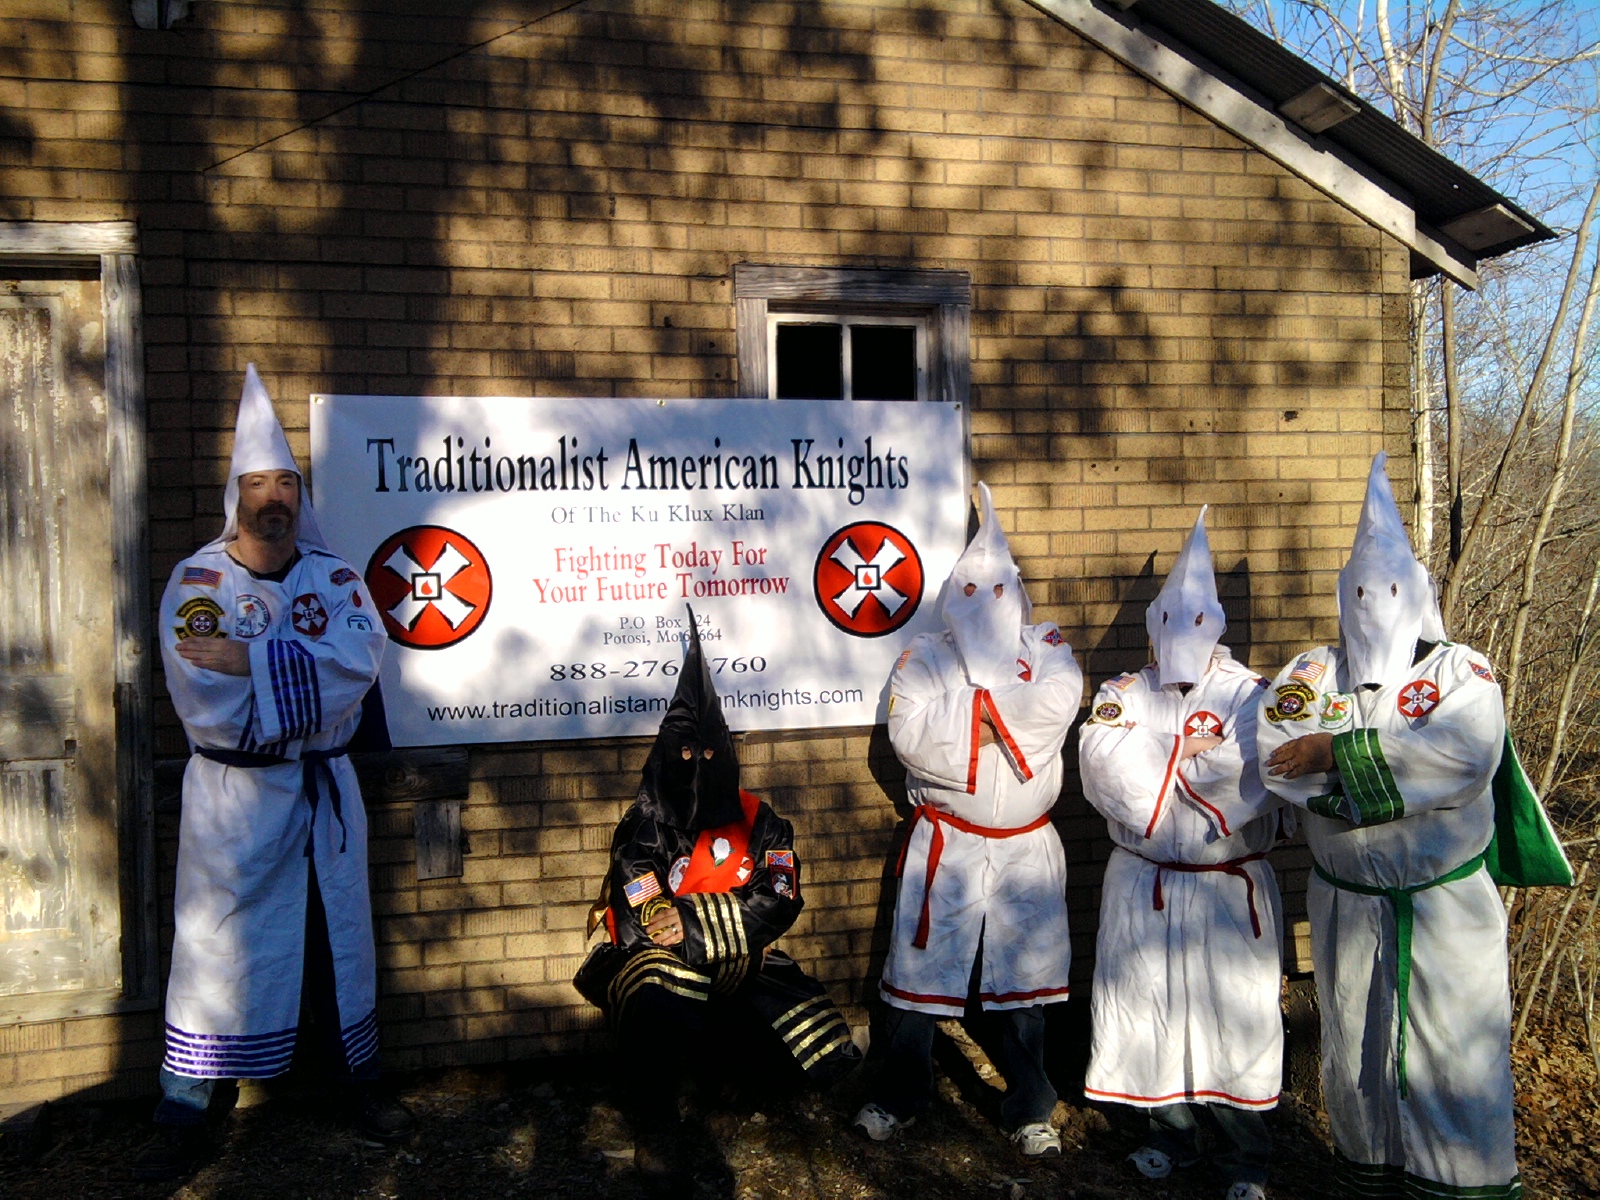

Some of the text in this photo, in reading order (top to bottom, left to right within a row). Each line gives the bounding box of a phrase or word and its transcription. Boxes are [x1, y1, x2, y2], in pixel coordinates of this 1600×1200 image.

[367, 435, 909, 505] Traditionalist American Knights
[551, 504, 765, 524] Of The Ku Klux Klan
[554, 541, 767, 580] Fighting Today For
[532, 572, 790, 604] Your Future Tomorrow
[655, 616, 682, 629] Box
[688, 614, 711, 628] 24
[603, 632, 651, 646] Potosi,
[683, 628, 722, 642] 6664
